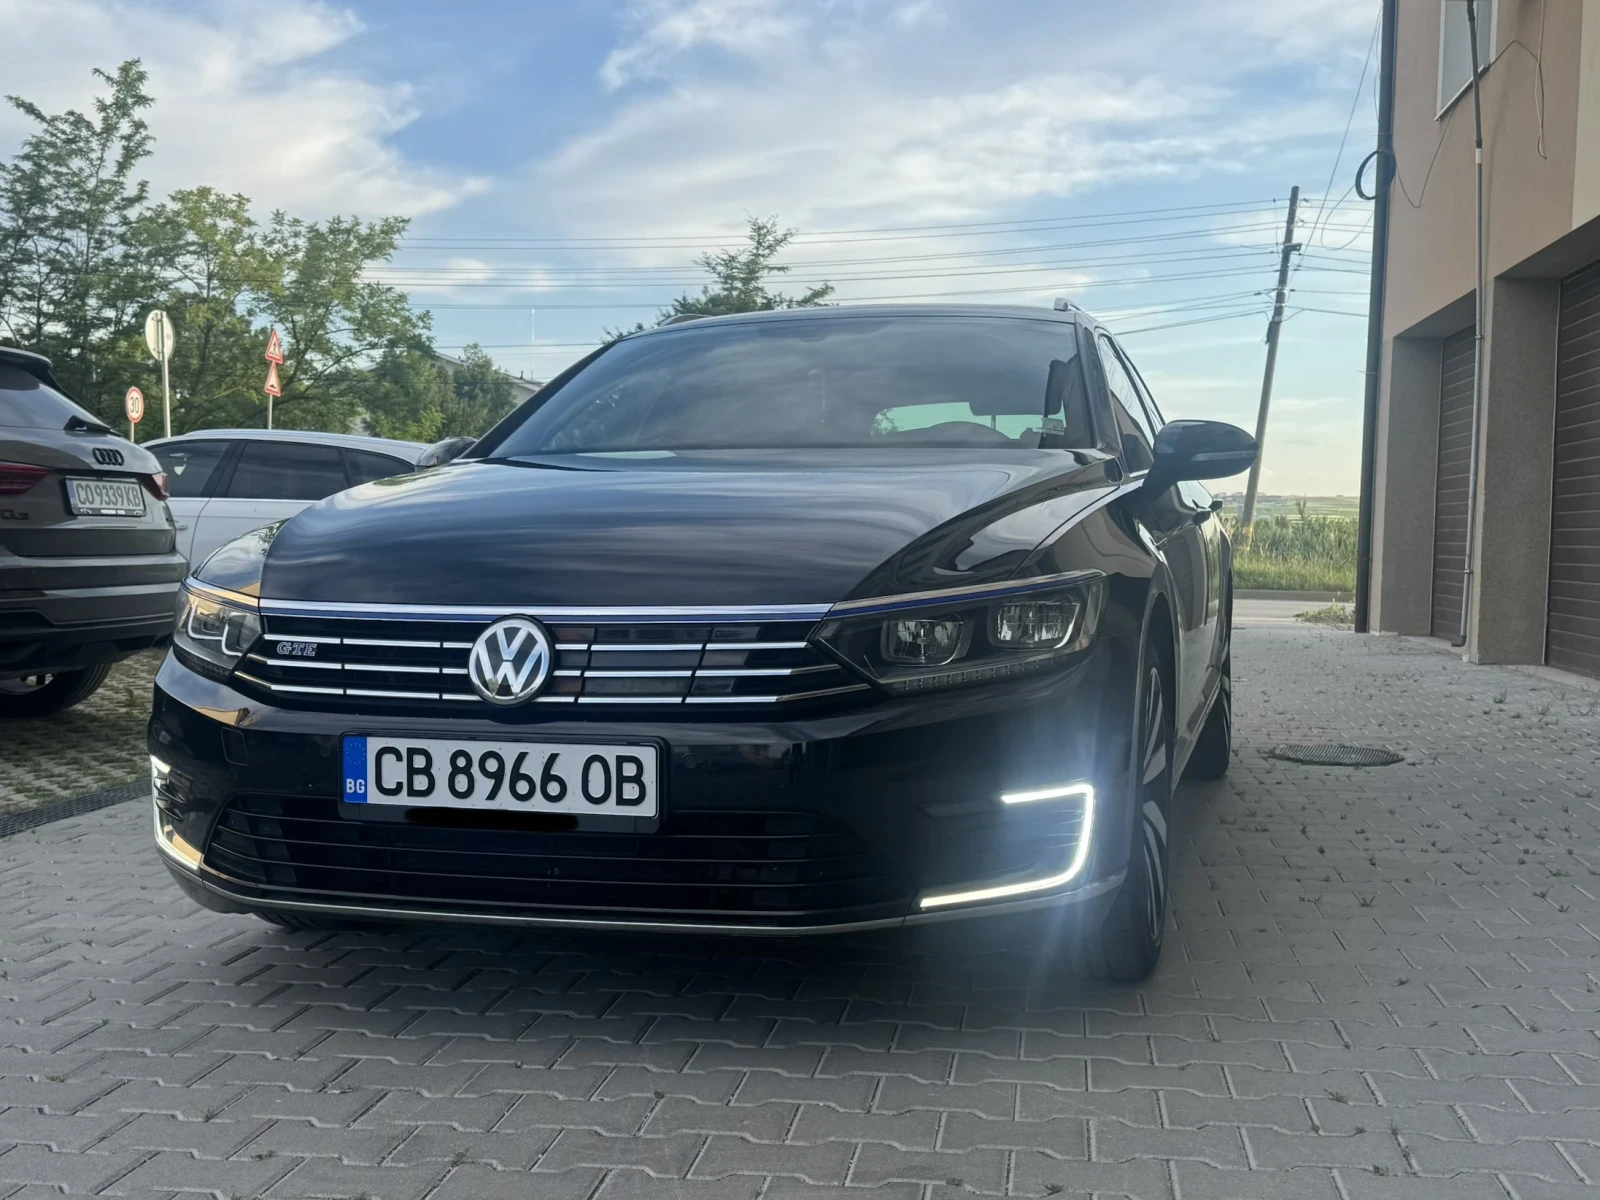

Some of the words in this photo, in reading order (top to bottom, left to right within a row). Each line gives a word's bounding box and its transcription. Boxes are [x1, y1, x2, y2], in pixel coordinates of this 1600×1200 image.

[130, 396, 140, 414] 30
[276, 641, 317, 657] GTE
[374, 746, 436, 798] CB
[448, 749, 568, 804] 8966
[581, 754, 647, 807] OB
[345, 778, 366, 794] BG
